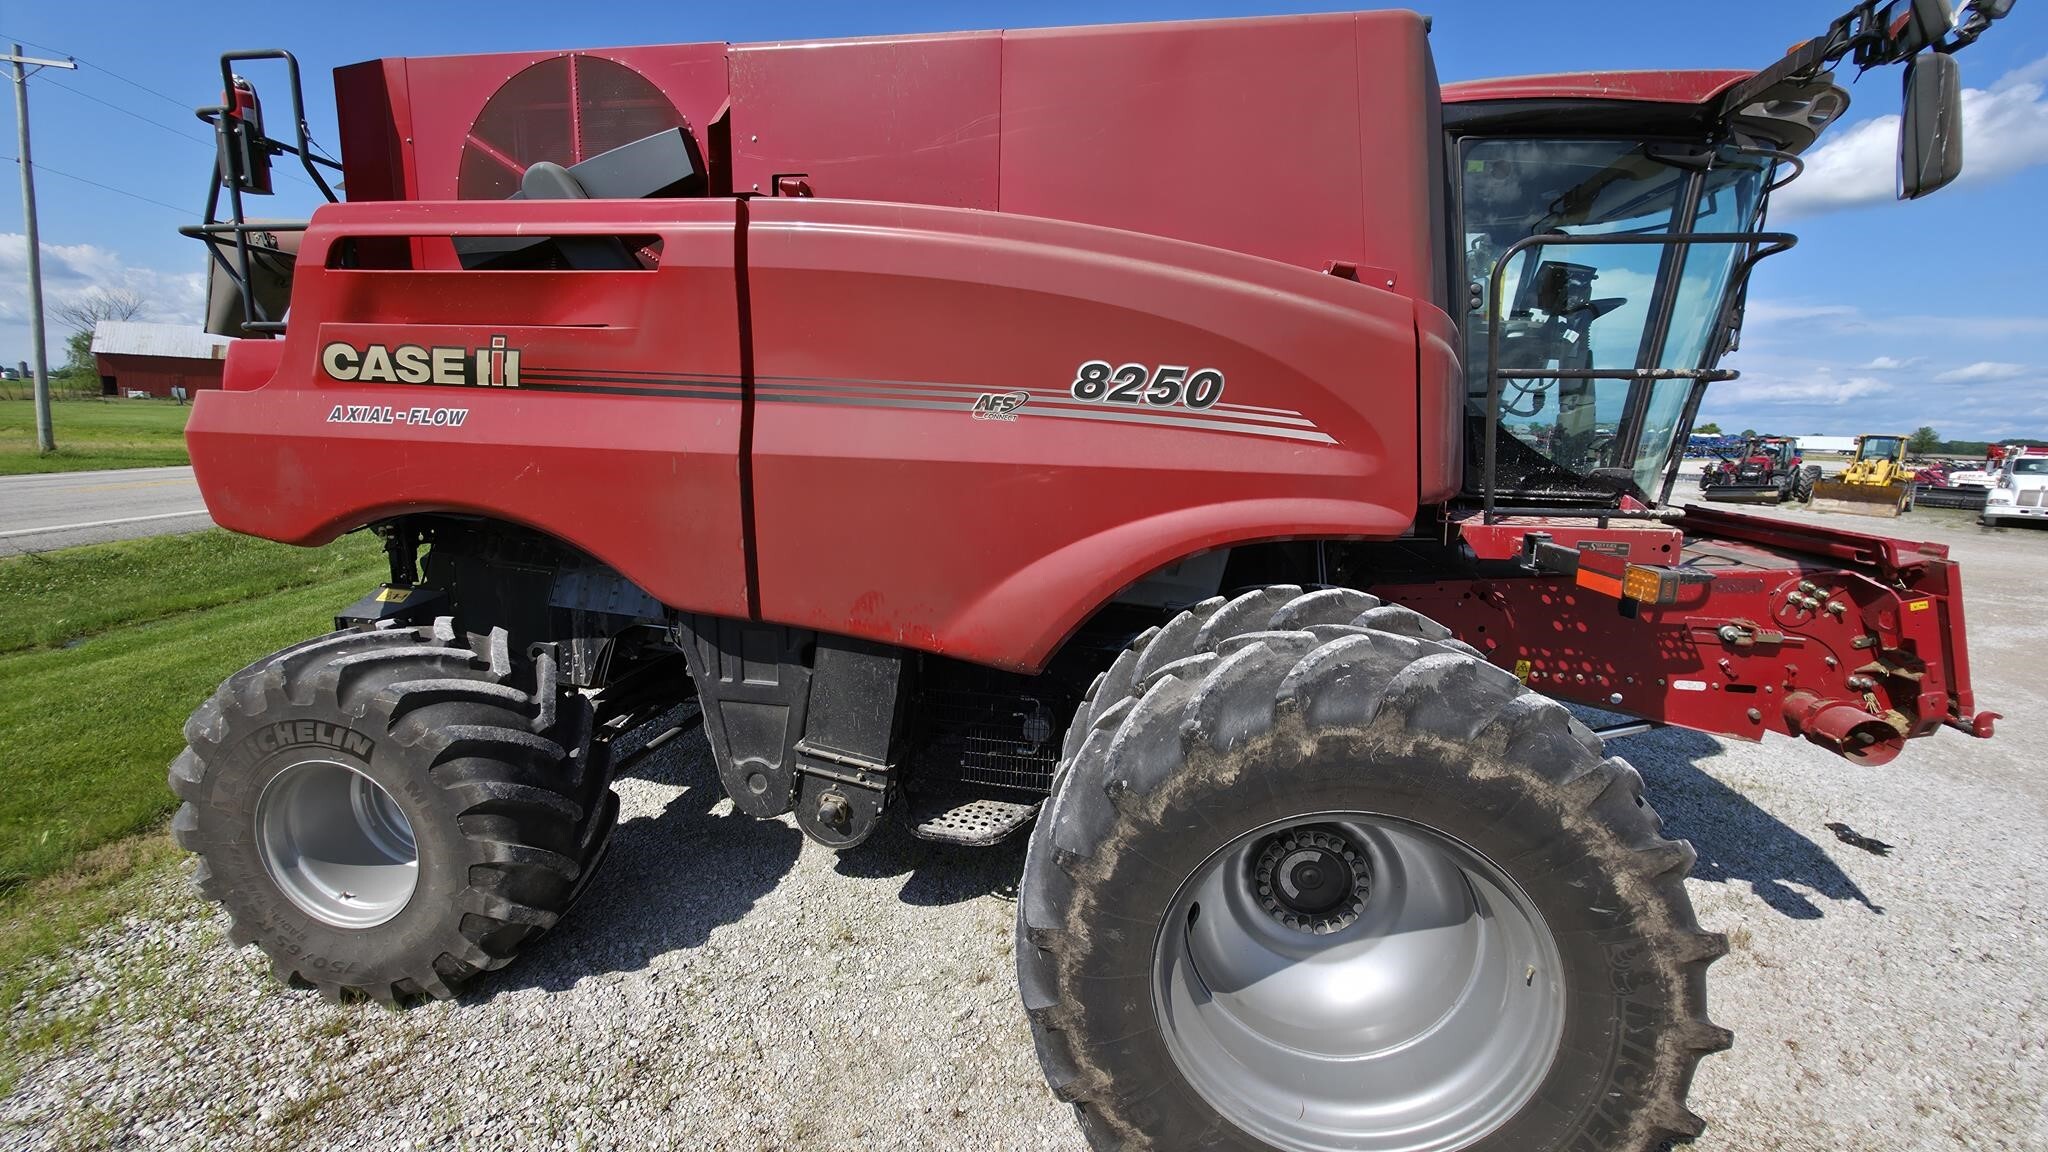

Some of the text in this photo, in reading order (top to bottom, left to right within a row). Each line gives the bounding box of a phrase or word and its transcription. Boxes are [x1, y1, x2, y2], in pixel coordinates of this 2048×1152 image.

[322, 342, 466, 385] CASE
[1071, 361, 1224, 411] 8250
[972, 393, 1018, 412] AFS
[983, 412, 1018, 422] CONNECT
